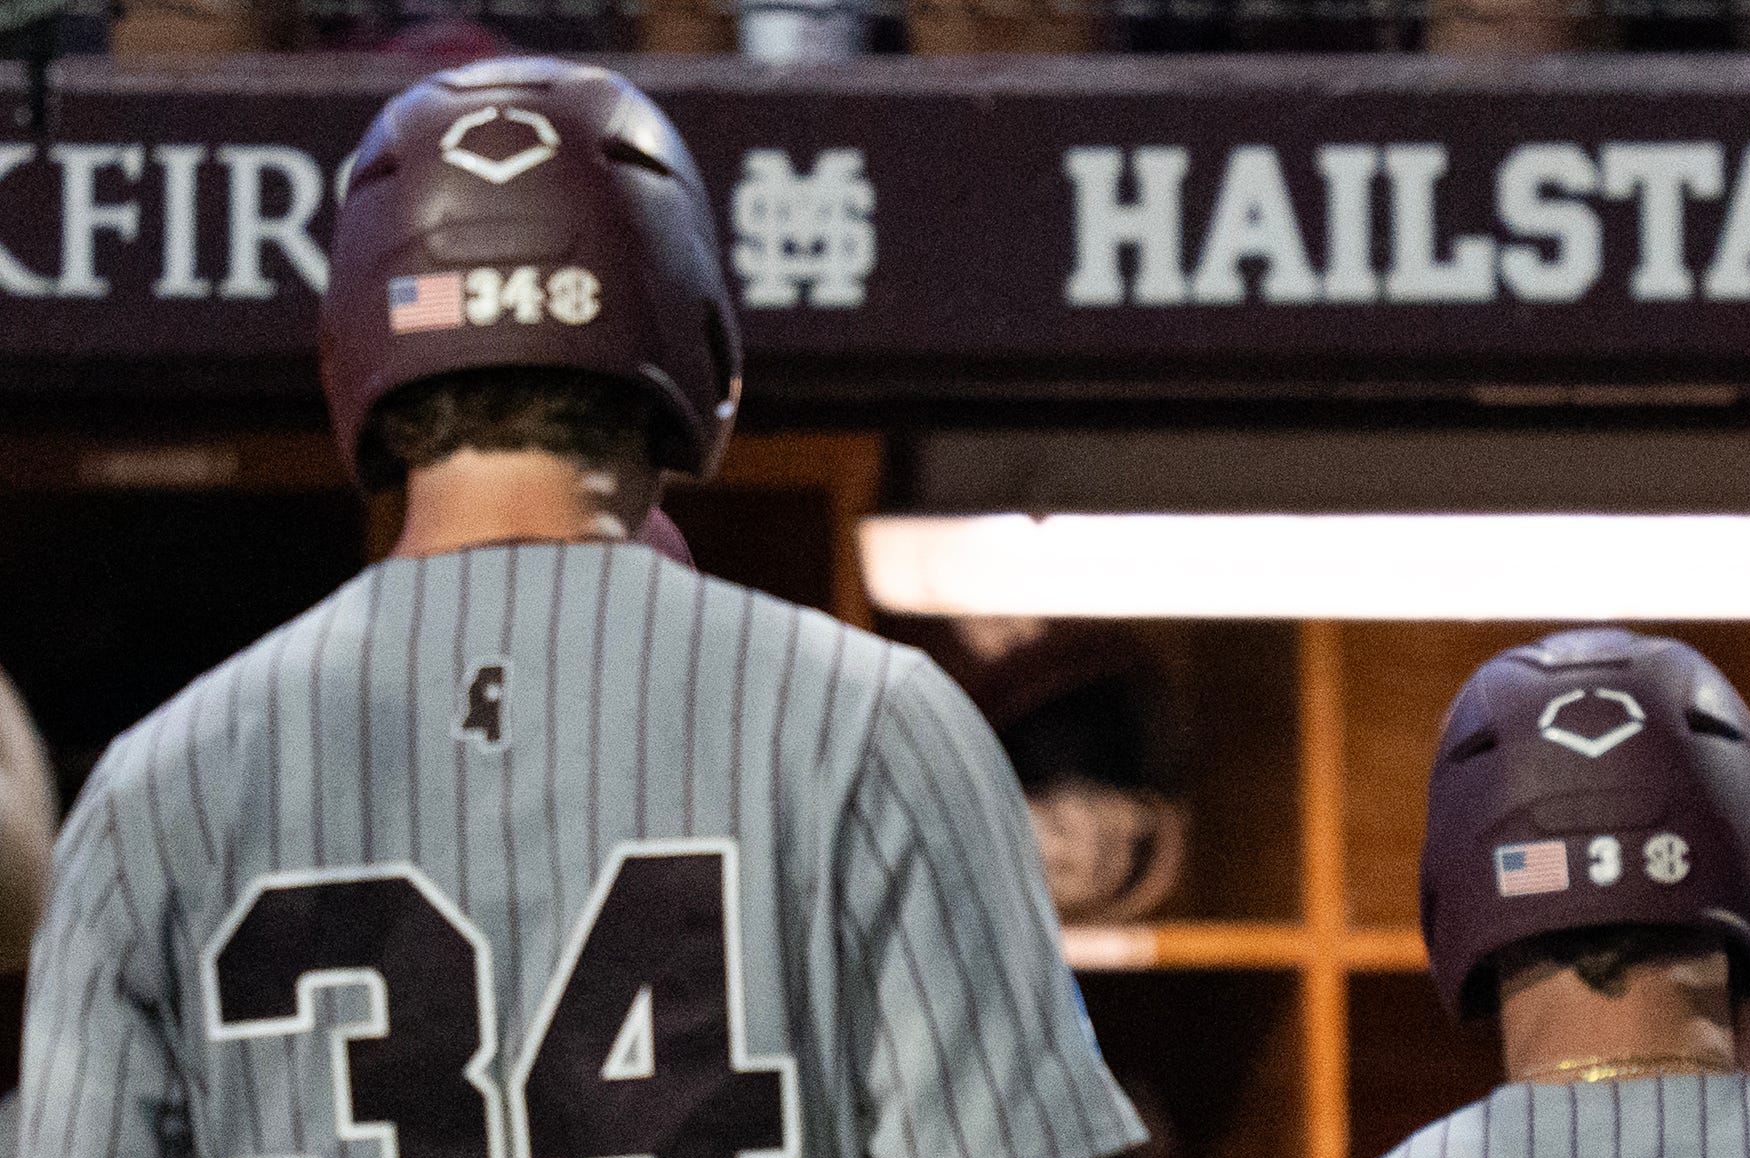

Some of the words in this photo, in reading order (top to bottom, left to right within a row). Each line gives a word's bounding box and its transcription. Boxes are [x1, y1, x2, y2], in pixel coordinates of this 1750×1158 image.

[0, 143, 356, 299] FIR
[464, 266, 545, 326] 34
[1588, 835, 1623, 886] 3
